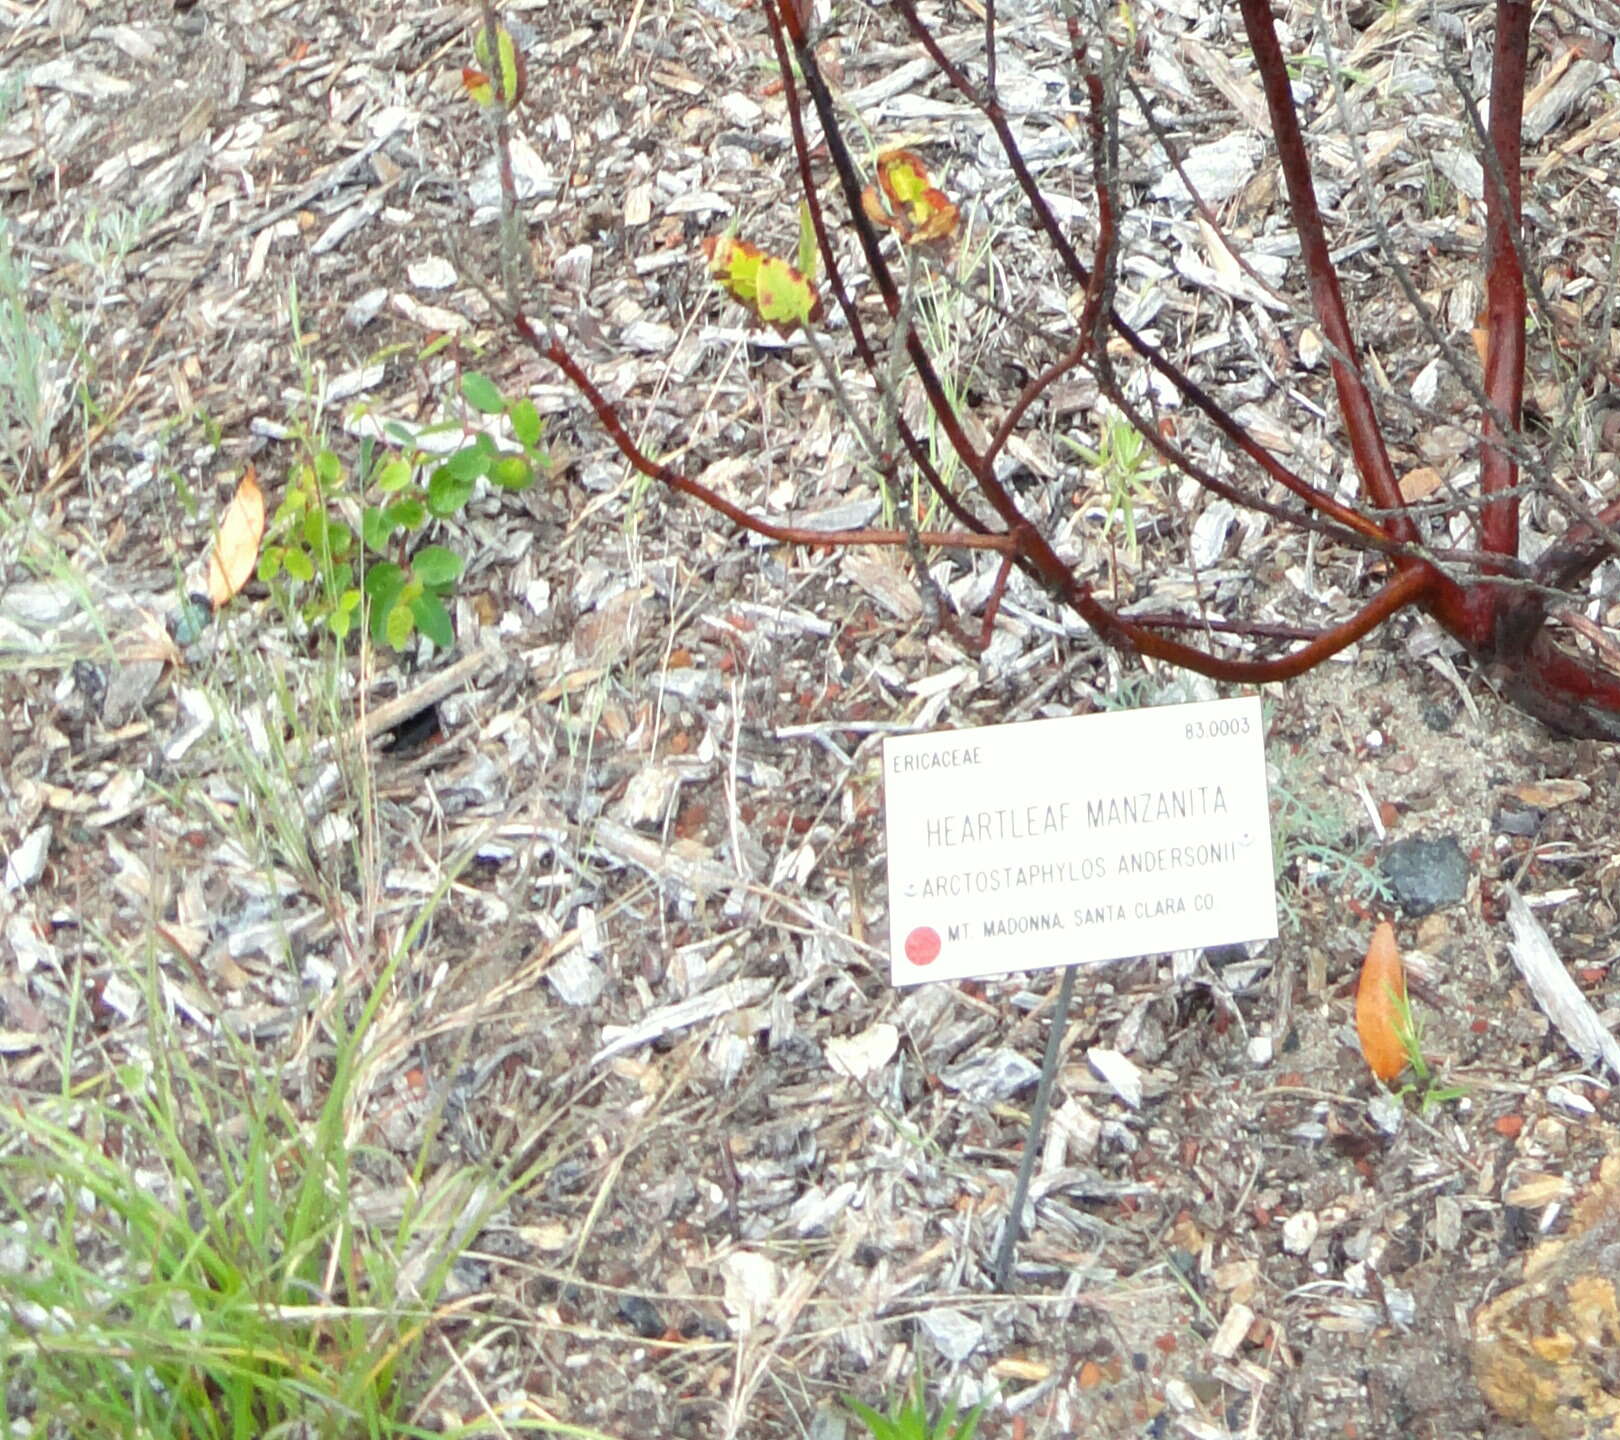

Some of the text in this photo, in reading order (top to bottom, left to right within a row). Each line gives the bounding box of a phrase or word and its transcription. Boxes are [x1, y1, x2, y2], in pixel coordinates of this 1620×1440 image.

[1184, 716, 1251, 740] 83.0003
[892, 746, 983, 773] ERICACEAE
[926, 785, 1228, 848] HEARTLEAF MANZANITA
[922, 841, 1236, 899] ARCTOSTAPHYLOS ANDERSONII
[1073, 905, 1127, 927] SANTA
[1134, 896, 1187, 919] CLARA
